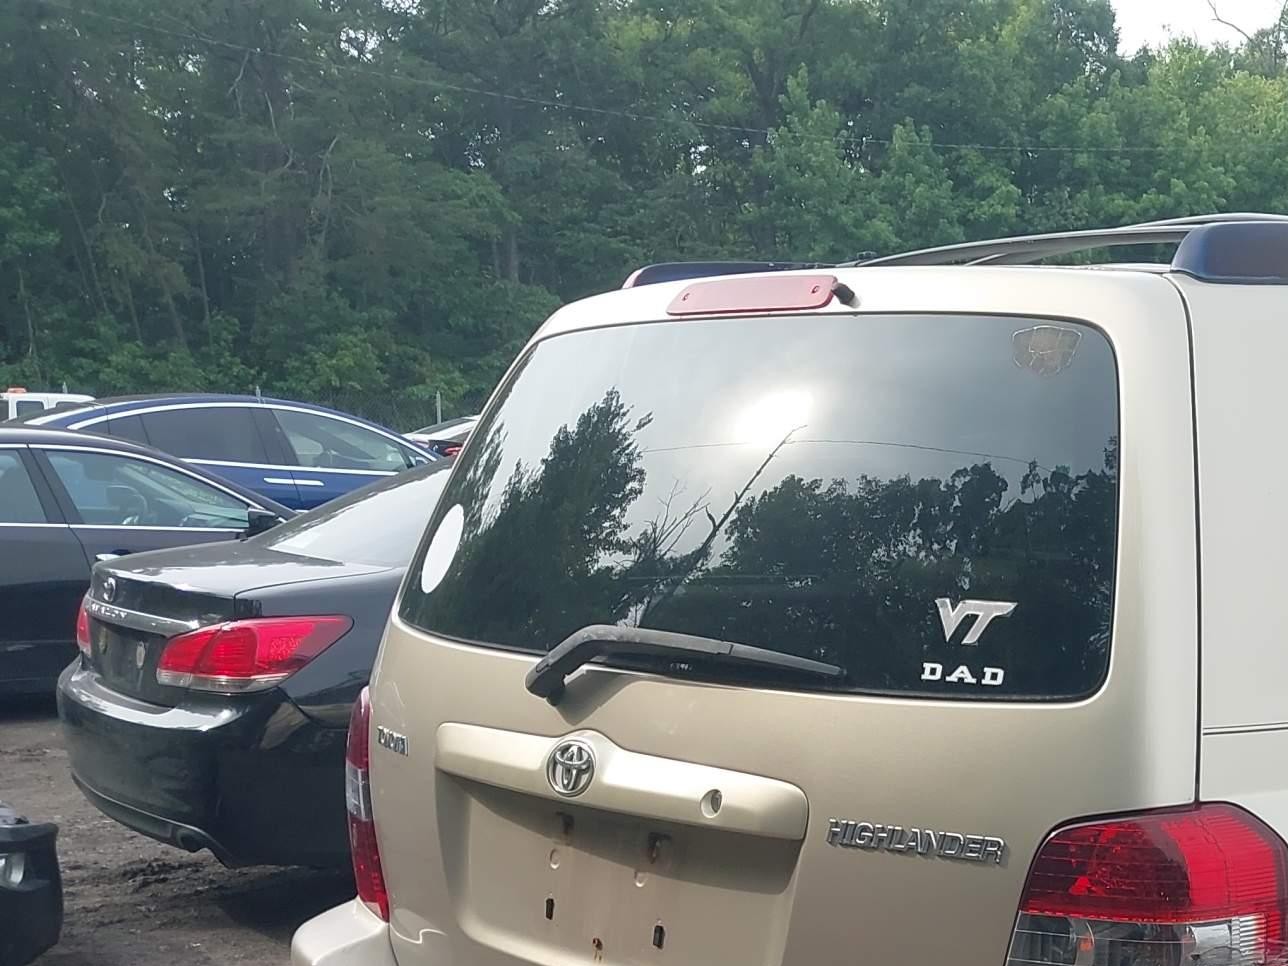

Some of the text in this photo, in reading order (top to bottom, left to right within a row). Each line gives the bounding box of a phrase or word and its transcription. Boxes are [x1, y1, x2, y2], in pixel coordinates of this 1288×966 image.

[935, 597, 1018, 646] VT
[920, 662, 1005, 686] DAD
[826, 818, 1005, 864] HIGHLANDER
